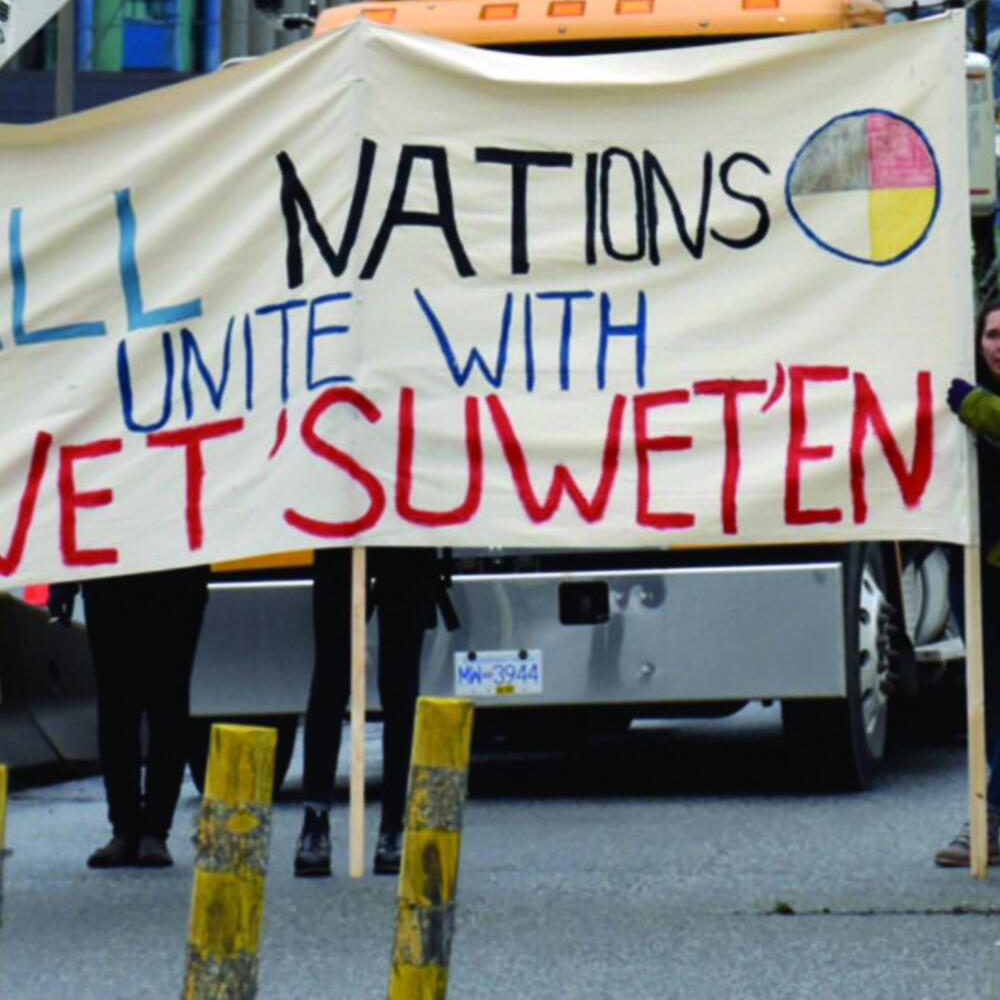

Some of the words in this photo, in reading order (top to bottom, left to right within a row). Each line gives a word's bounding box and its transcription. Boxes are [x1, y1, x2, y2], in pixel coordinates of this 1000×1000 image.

[0, 188, 202, 347] LL
[276, 137, 771, 290] NATIONS
[117, 291, 355, 433] UNITE
[413, 290, 646, 392] WITH
